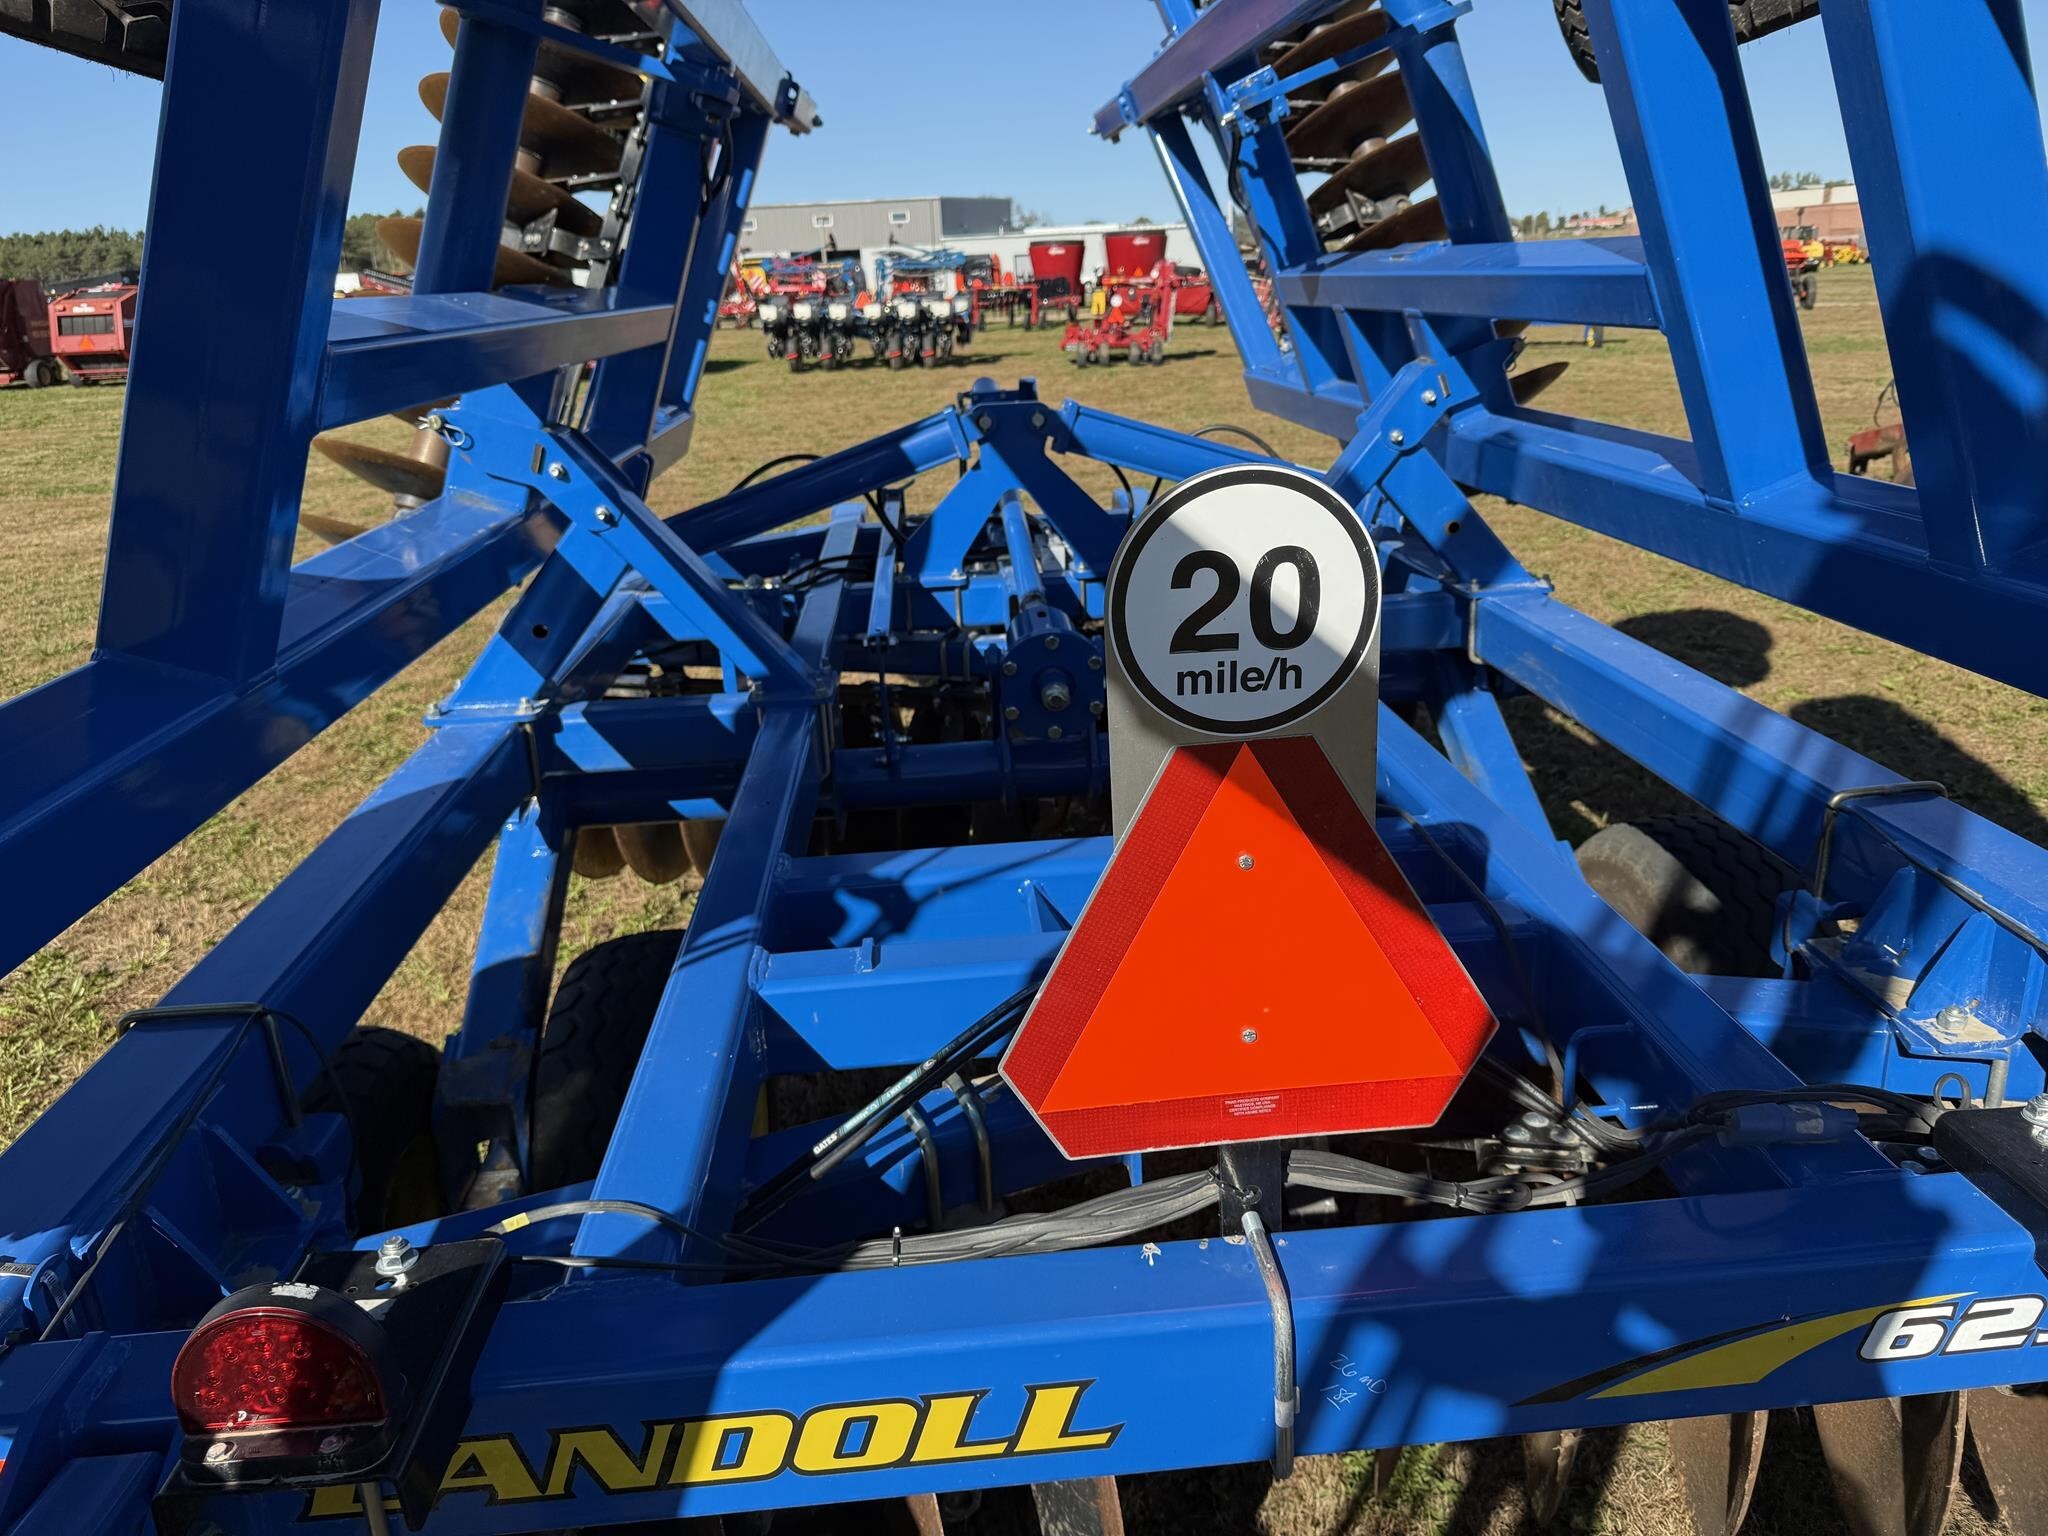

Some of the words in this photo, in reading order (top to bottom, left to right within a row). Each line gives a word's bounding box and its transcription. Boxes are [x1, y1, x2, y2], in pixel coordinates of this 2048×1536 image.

[1169, 545, 1321, 655] 20
[1177, 657, 1302, 696] mile/h
[1857, 1293, 2048, 1364] 62
